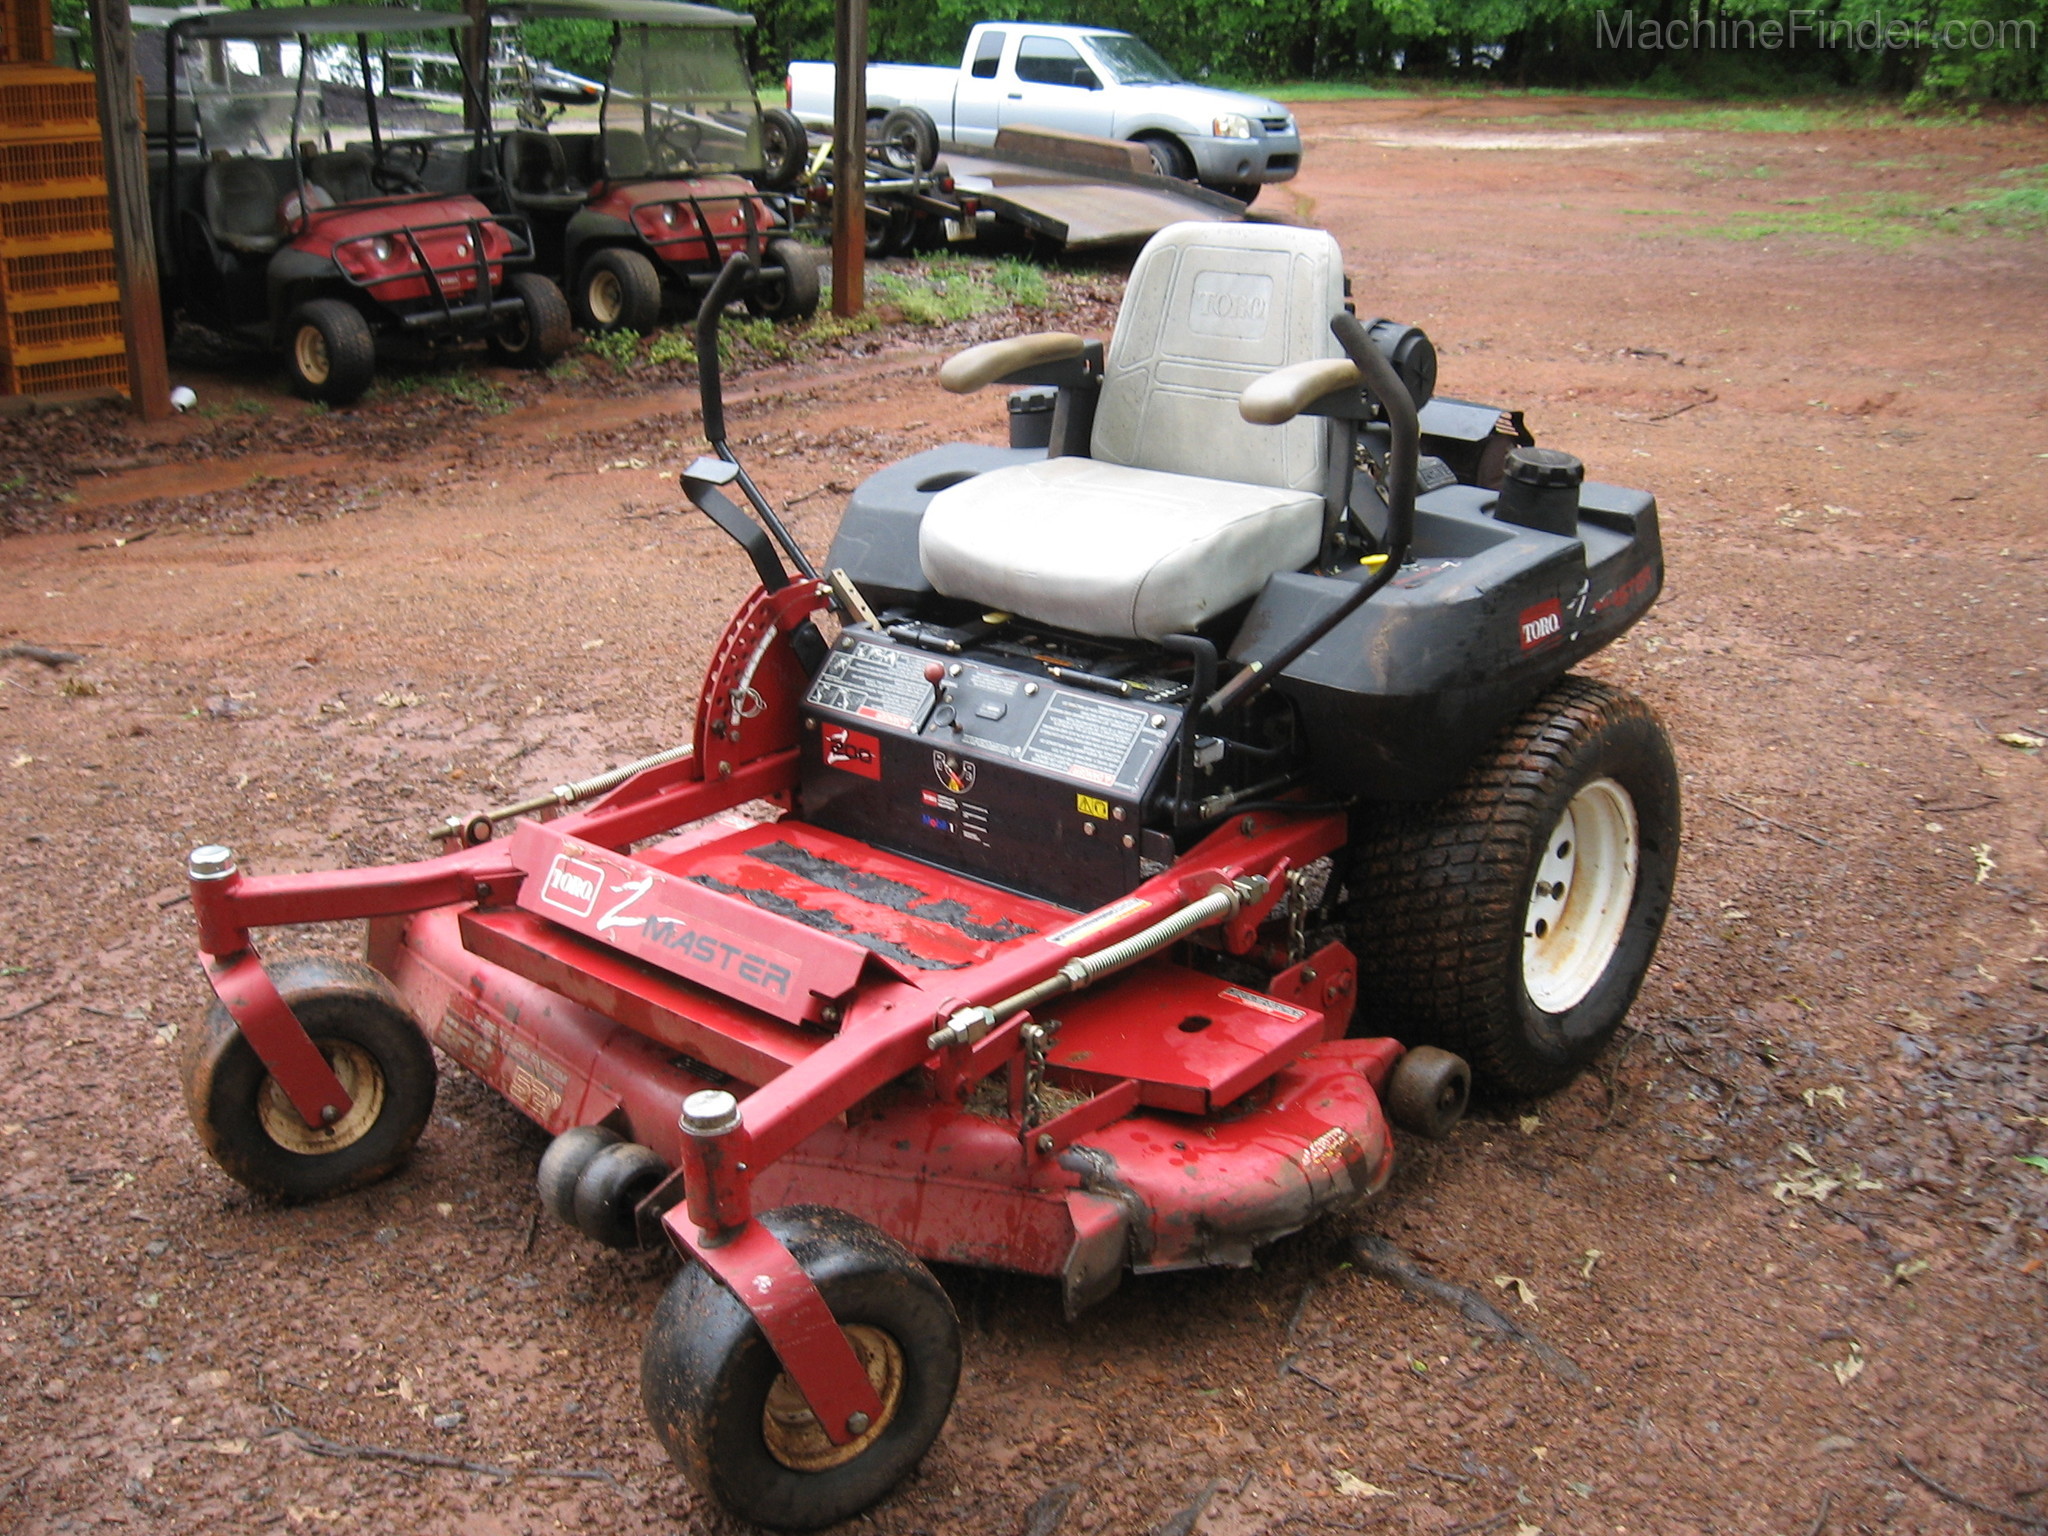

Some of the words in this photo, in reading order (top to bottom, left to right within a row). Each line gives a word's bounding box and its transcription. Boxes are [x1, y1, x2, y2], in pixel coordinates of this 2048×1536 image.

[1198, 291, 1267, 321] TORO
[1522, 613, 1561, 643] TORO
[550, 868, 595, 902] TORO
[597, 876, 687, 931] Z
[642, 914, 793, 996] MASTER
